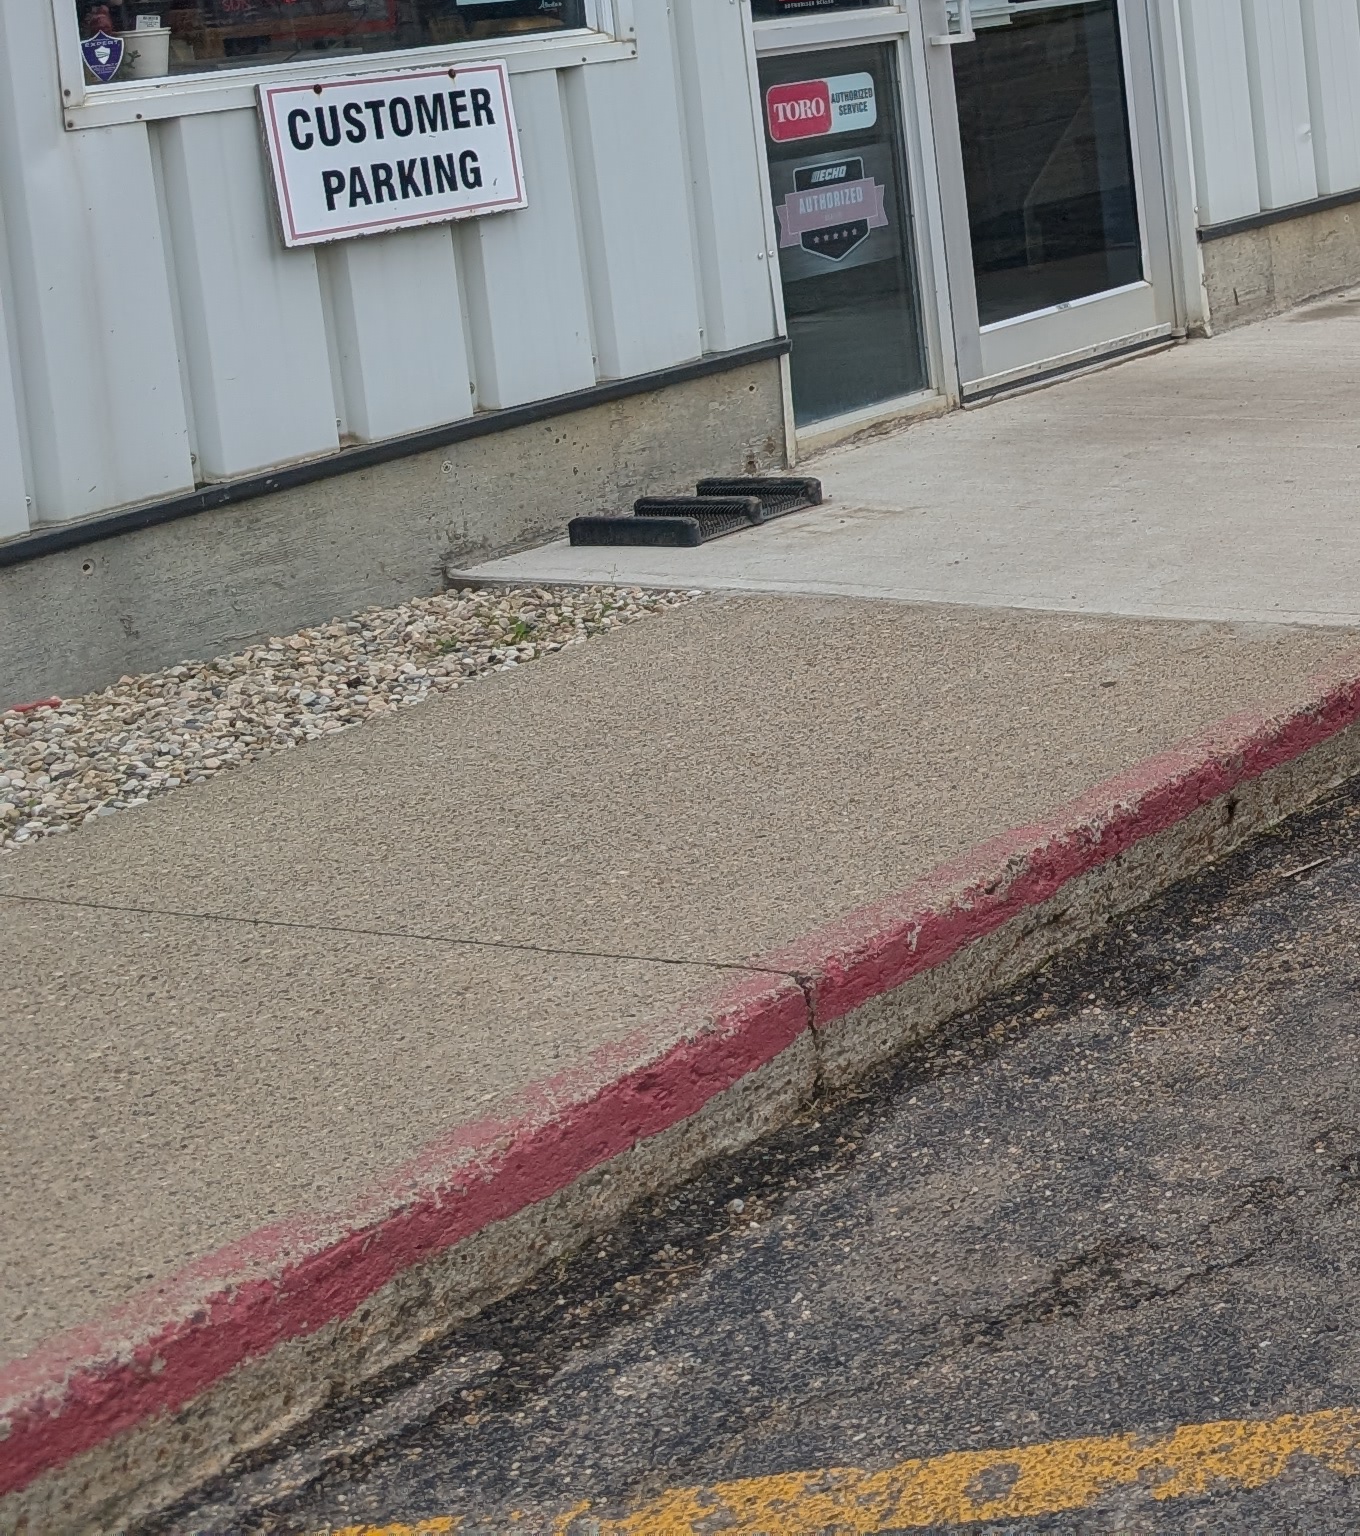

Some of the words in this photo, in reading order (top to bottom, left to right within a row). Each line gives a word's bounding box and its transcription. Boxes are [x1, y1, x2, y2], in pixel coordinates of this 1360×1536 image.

[831, 87, 874, 104] AUTHORIZED
[287, 87, 497, 152] CUSTOMER
[773, 97, 826, 123] TORO
[838, 101, 869, 117] SERVICE
[321, 149, 483, 211] PARKING
[820, 165, 847, 180] ECHO
[799, 185, 864, 215] AUTHORIZED
